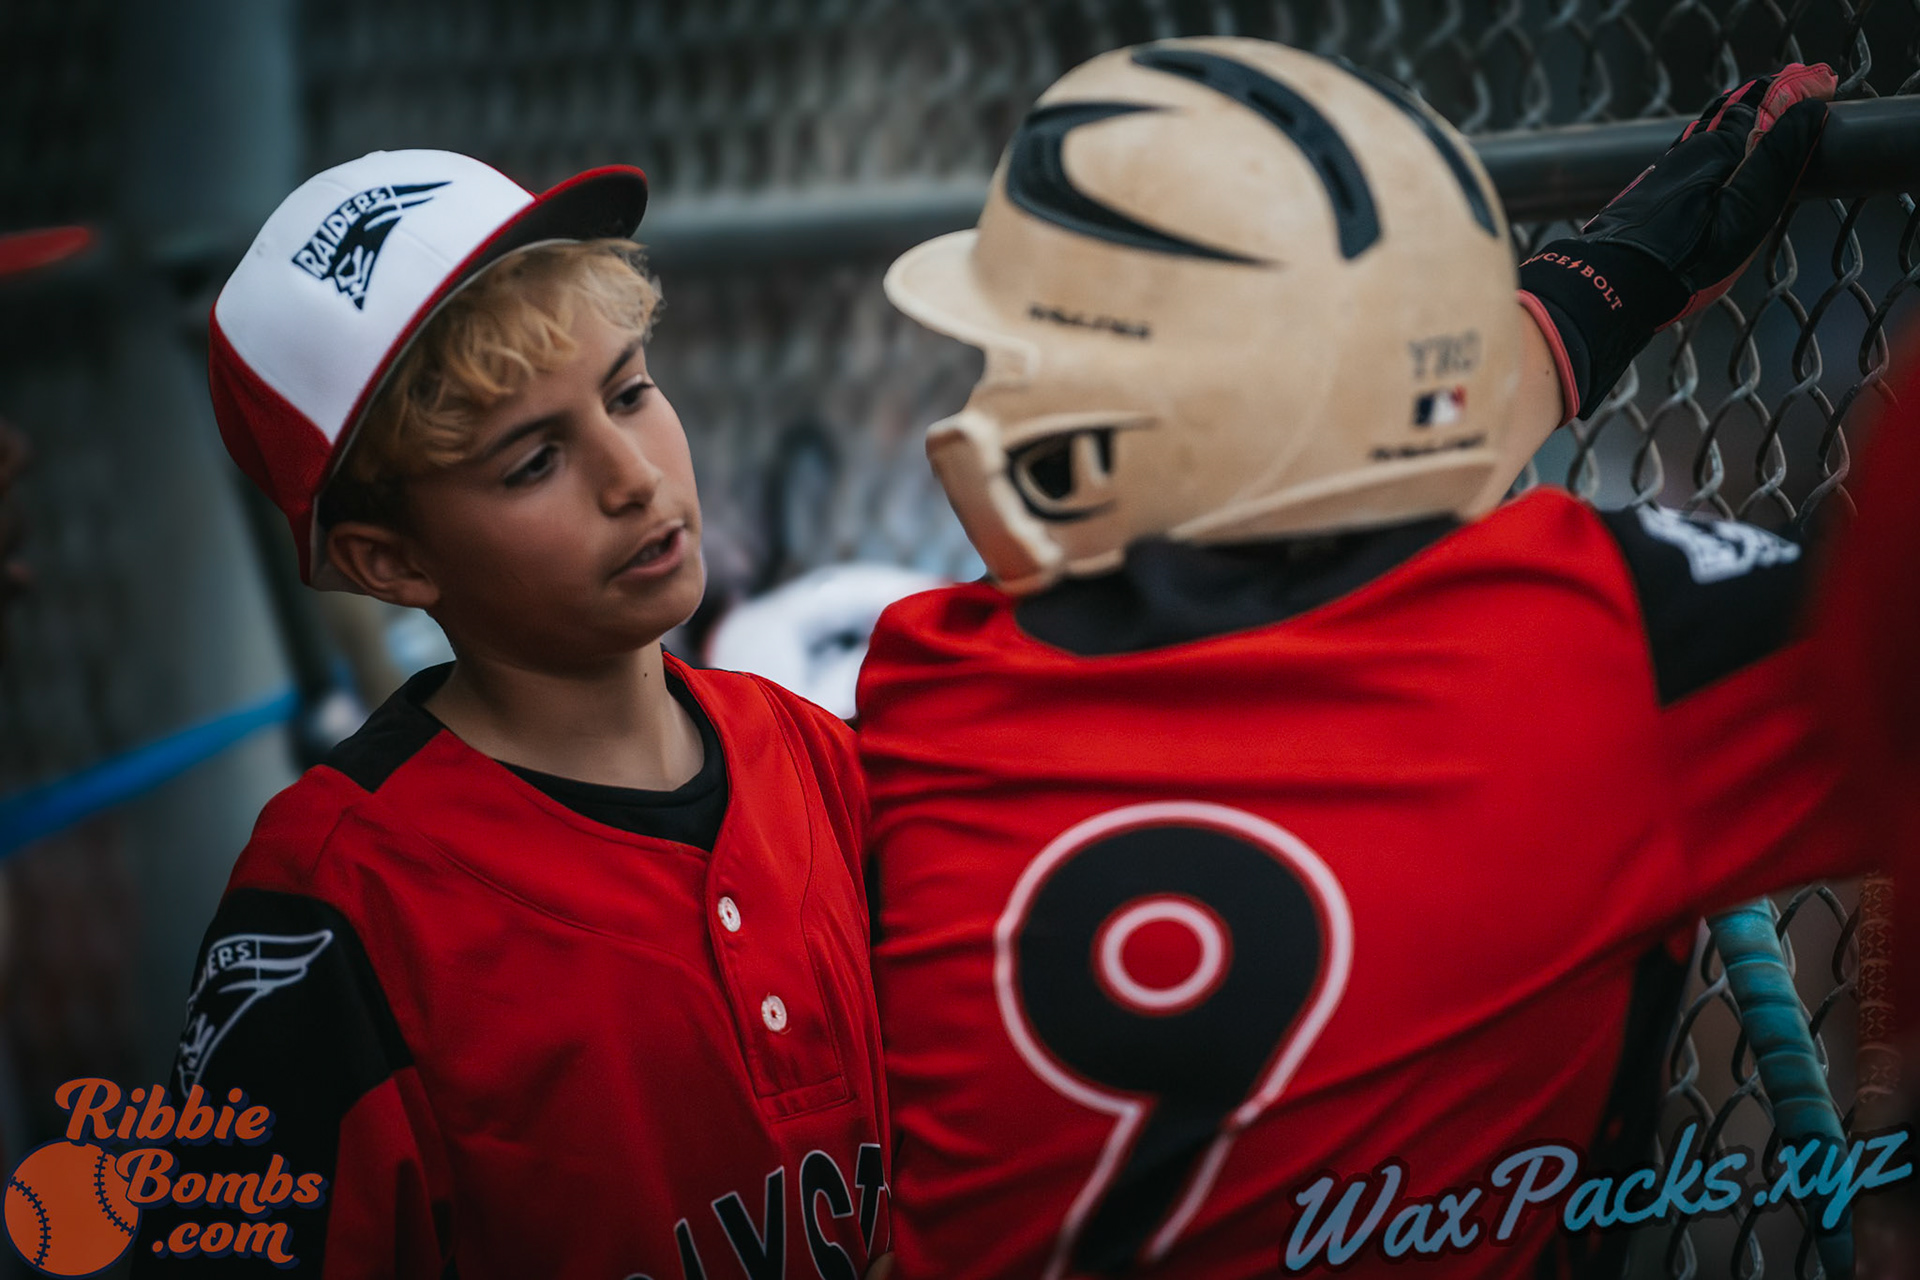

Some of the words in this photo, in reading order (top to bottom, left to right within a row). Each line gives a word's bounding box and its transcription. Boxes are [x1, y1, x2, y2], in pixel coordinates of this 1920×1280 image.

[294, 186, 389, 278] RAIDERS
[1580, 265, 1623, 311] BOLT
[994, 800, 1354, 1280] 9
